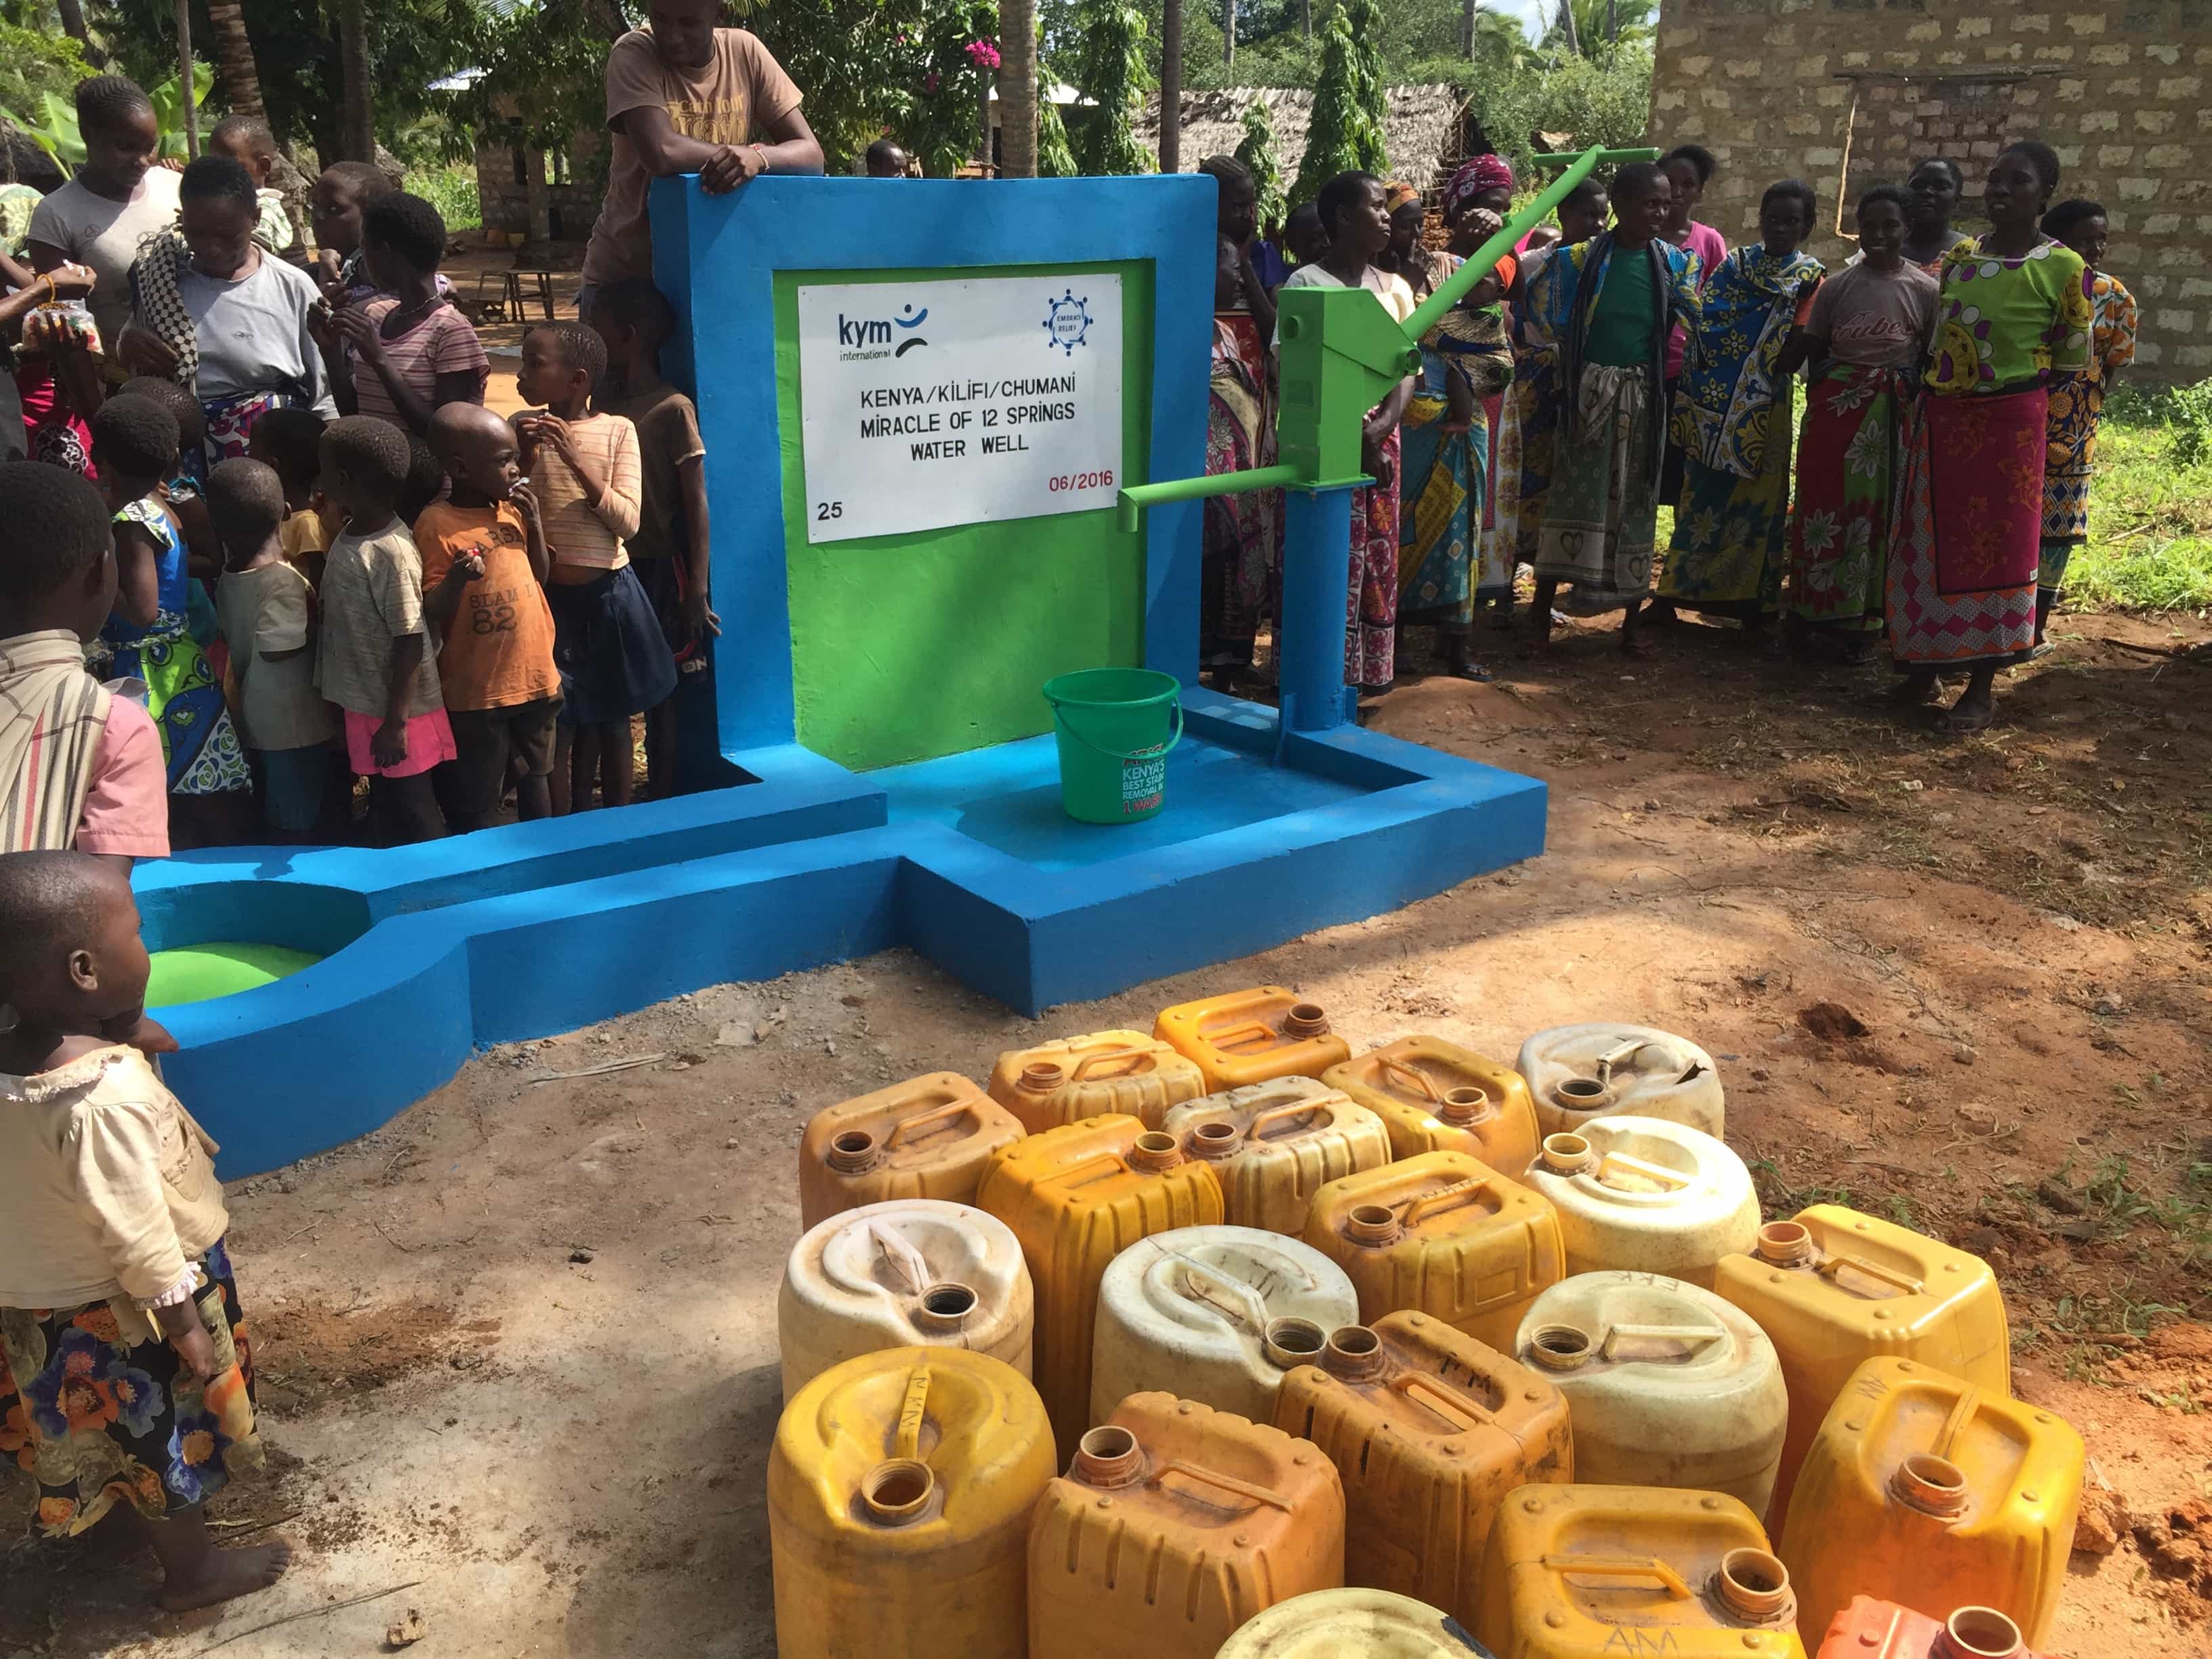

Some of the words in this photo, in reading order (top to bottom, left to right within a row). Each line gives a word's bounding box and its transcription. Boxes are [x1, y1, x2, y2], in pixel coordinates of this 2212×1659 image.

[839, 314, 891, 348] kym
[840, 349, 890, 361] international
[949, 411, 972, 430] OF
[982, 409, 998, 427] 12
[911, 440, 966, 462] WATER
[981, 434, 1029, 454] WELL
[1049, 470, 1113, 491] 06/2016
[817, 501, 842, 520] 25
[470, 588, 520, 609] SLAM
[472, 606, 518, 635] 82
[1123, 779, 1145, 790] BEST
[1123, 786, 1156, 800] REMOVAL
[1123, 800, 1131, 813] 1
